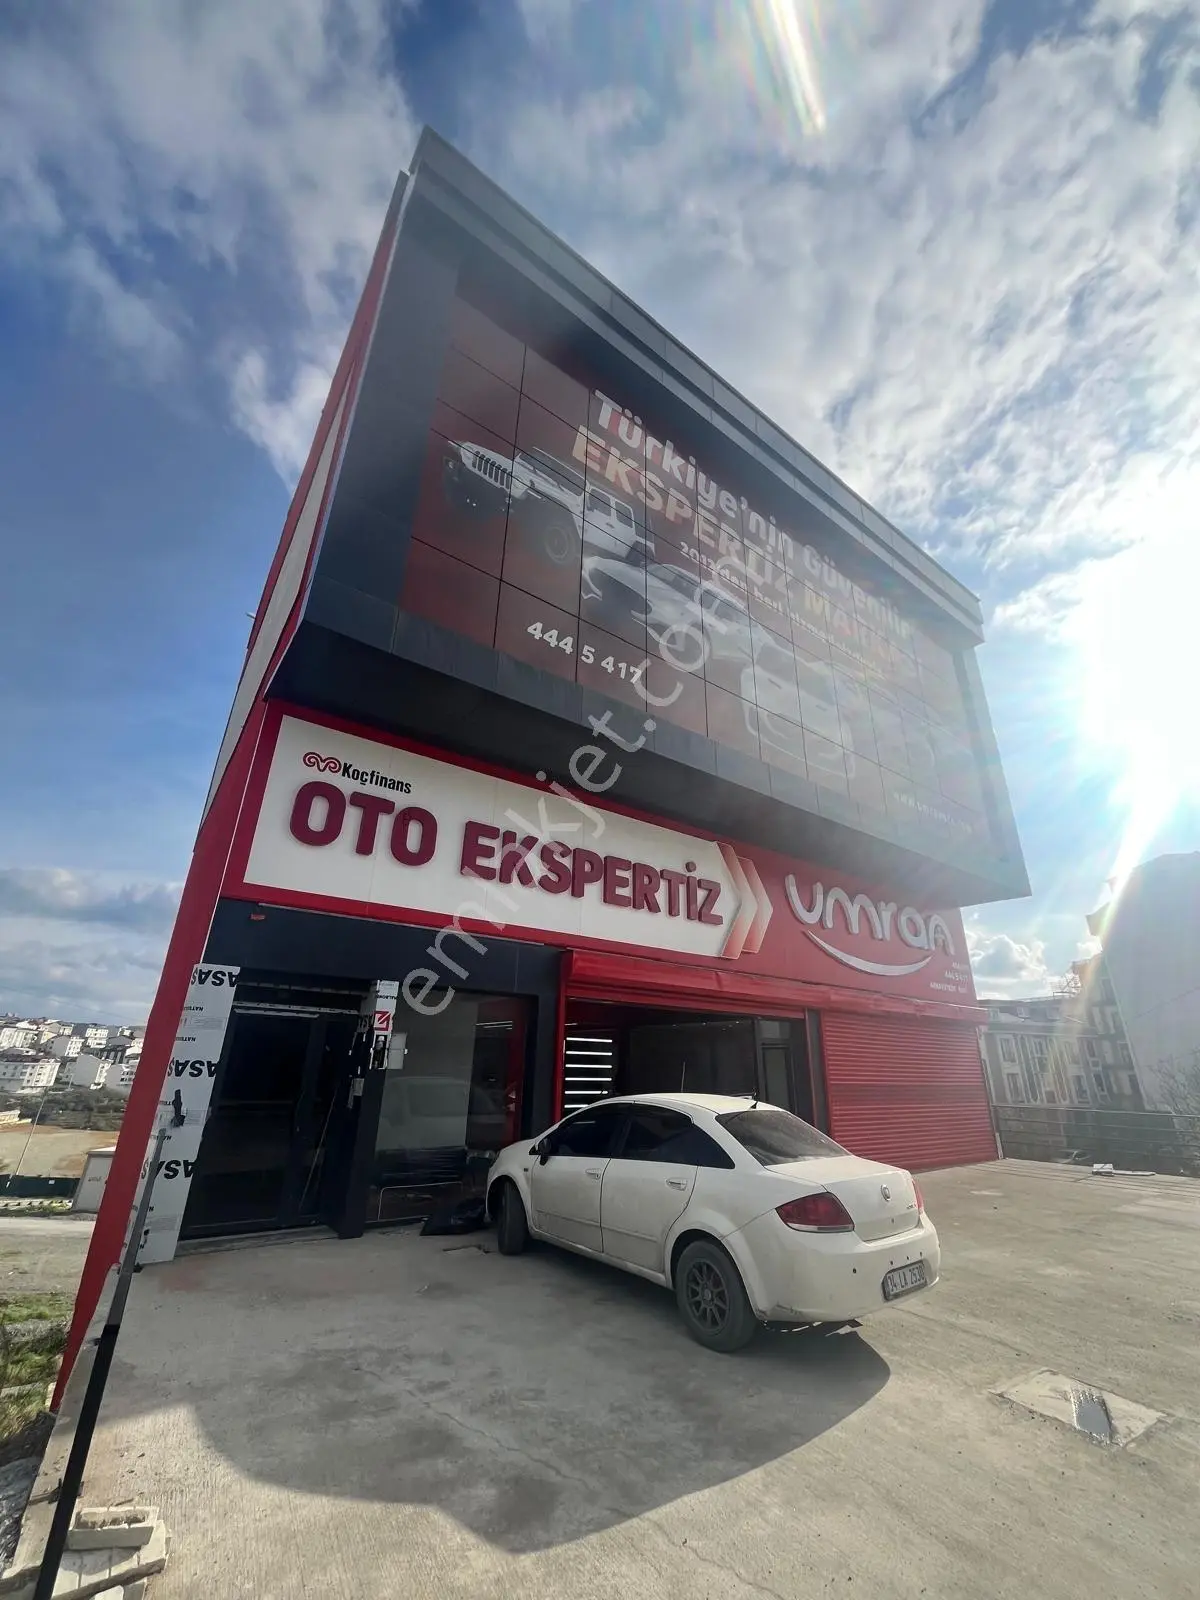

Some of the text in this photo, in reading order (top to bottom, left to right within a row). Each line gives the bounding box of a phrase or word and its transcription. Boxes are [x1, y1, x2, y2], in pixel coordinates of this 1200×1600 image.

[572, 424, 794, 600] EKSPERTİZ
[595, 389, 794, 559] Türkiye'nin
[527, 621, 643, 685] 444 5 417
[341, 762, 412, 794] Koçfinans
[290, 780, 723, 926] OTO EKSPERTİZ
